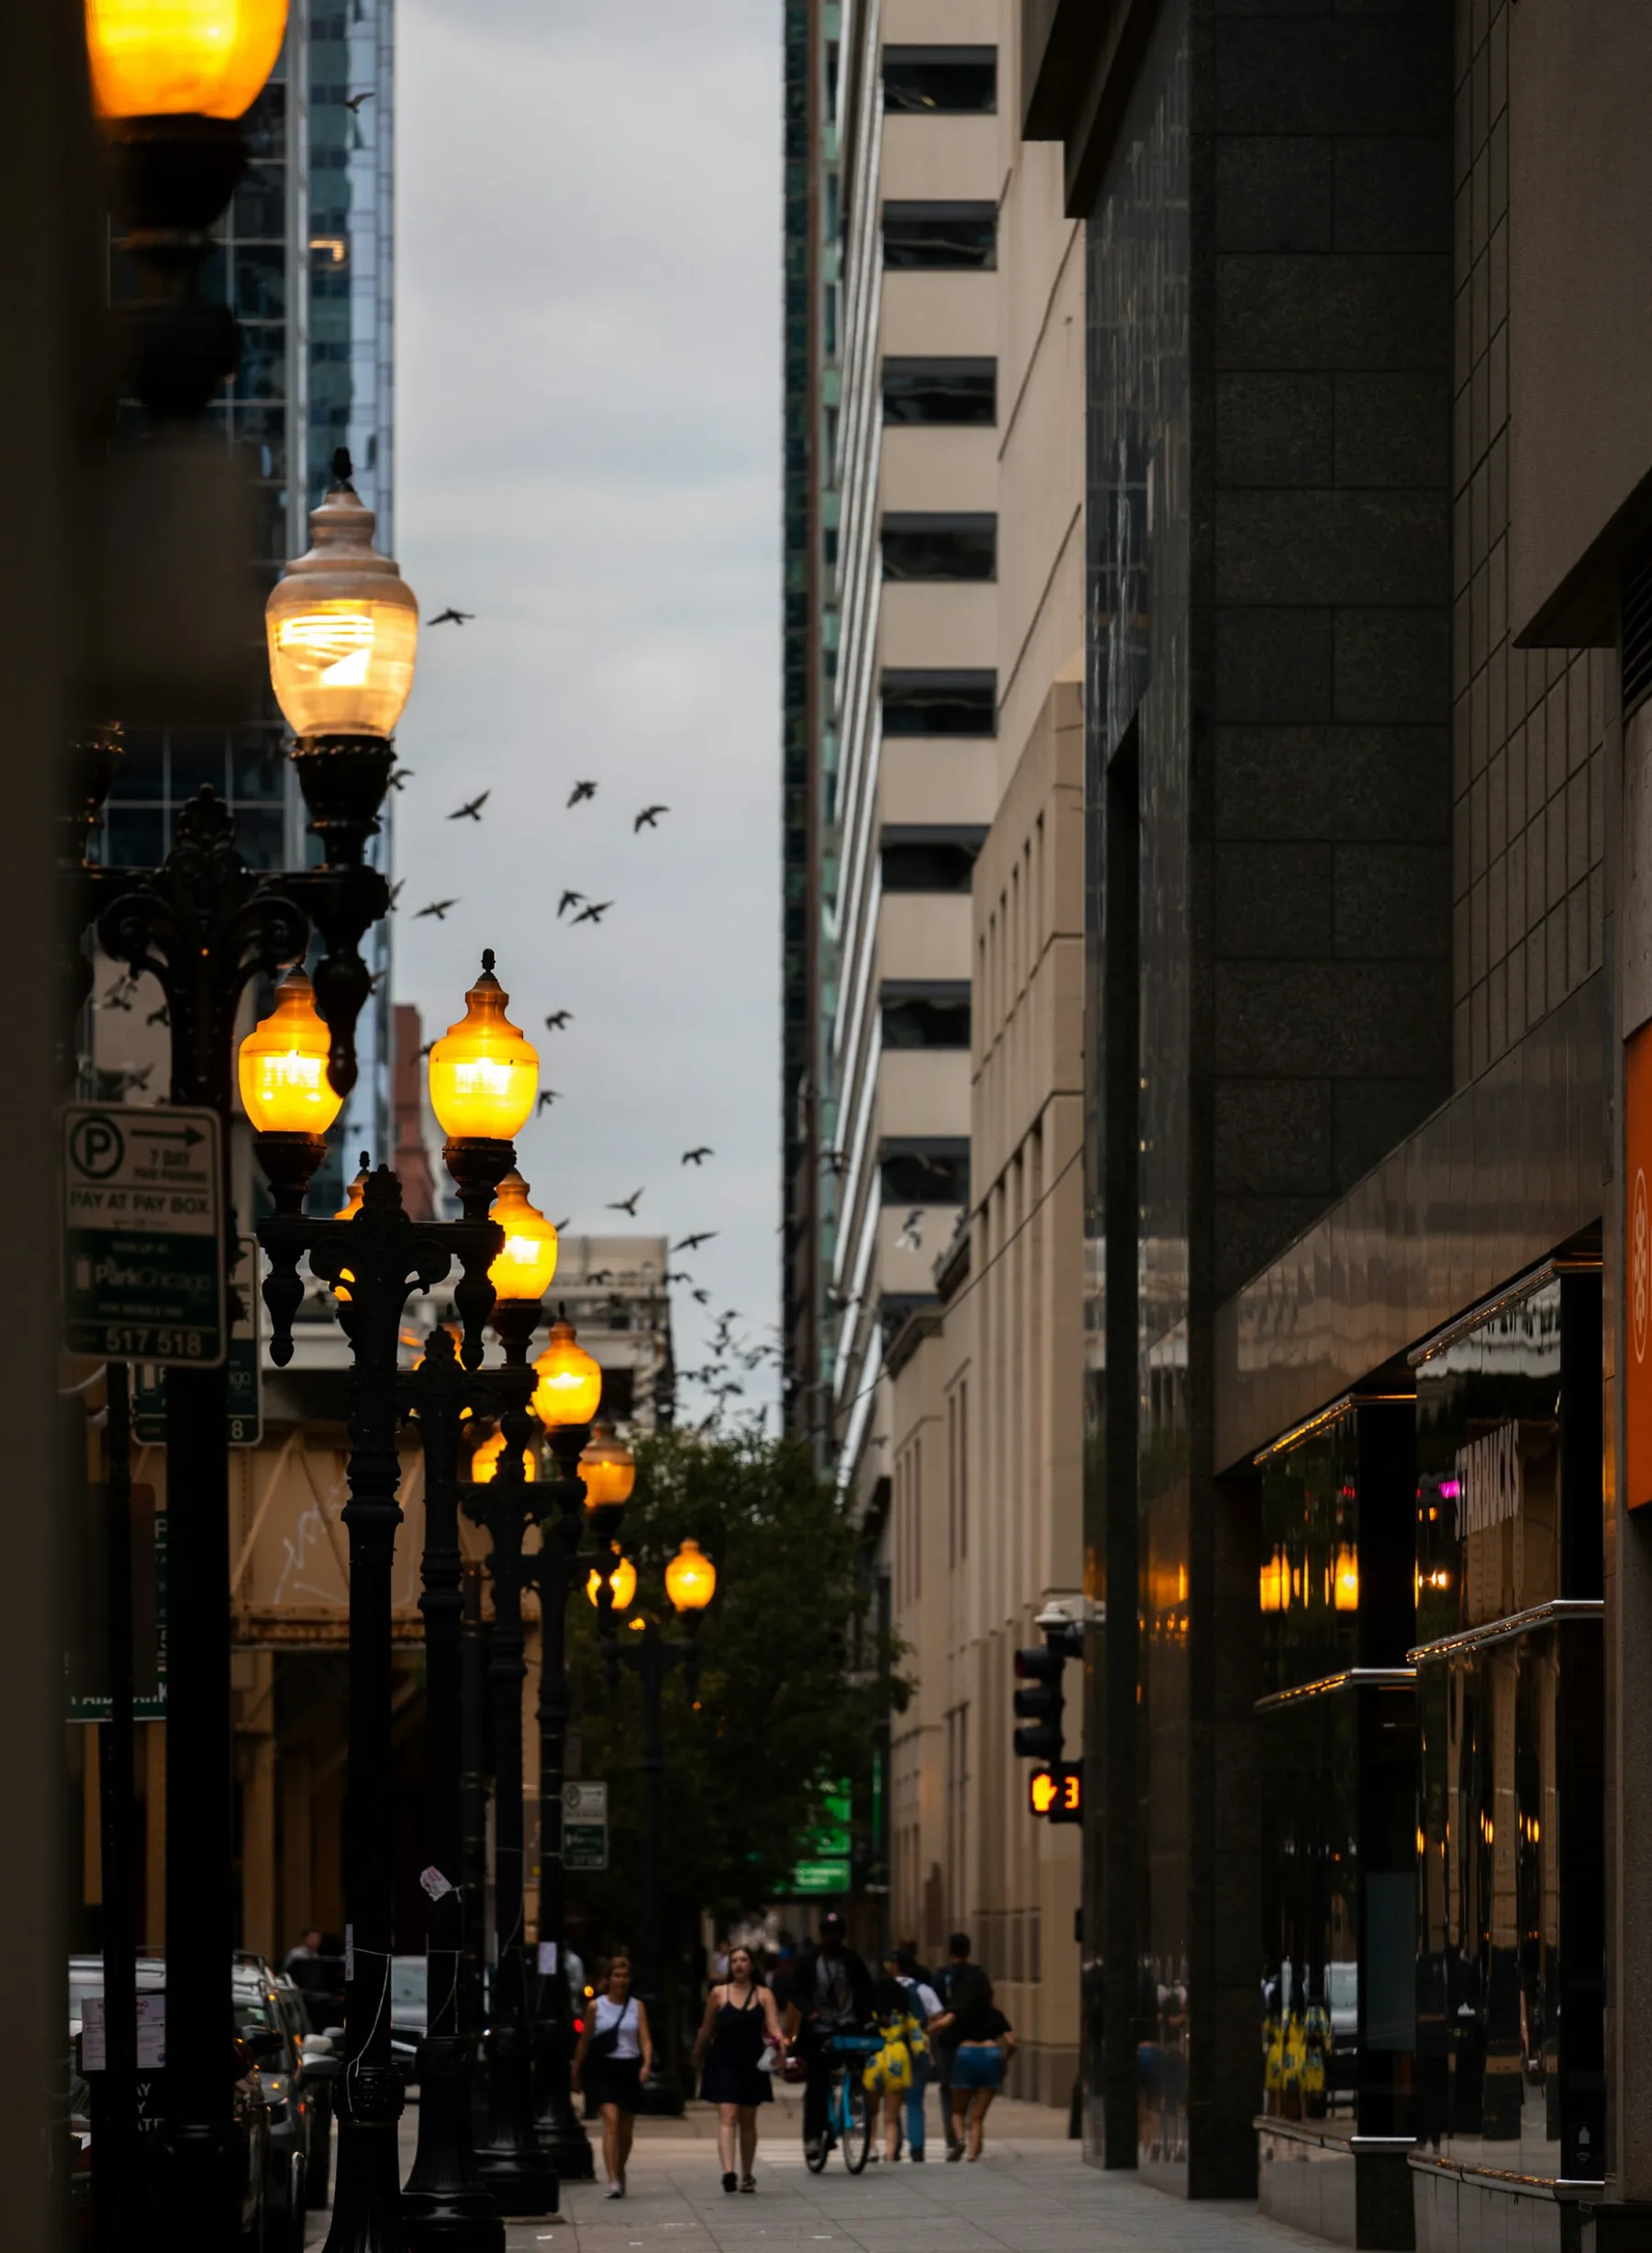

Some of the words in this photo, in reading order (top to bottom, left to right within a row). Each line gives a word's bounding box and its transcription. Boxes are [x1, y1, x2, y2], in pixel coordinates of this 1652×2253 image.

[84, 1127, 111, 1167] P
[71, 1190, 103, 1209] PAY
[106, 1192, 128, 1210] AT
[133, 1193, 166, 1212] PAY
[170, 1196, 210, 1217] BOX
[106, 1327, 149, 1352] 517
[158, 1329, 201, 1355] 518
[1455, 1418, 1520, 1542] STARBUCKS
[1064, 1775, 1080, 1810] 3
